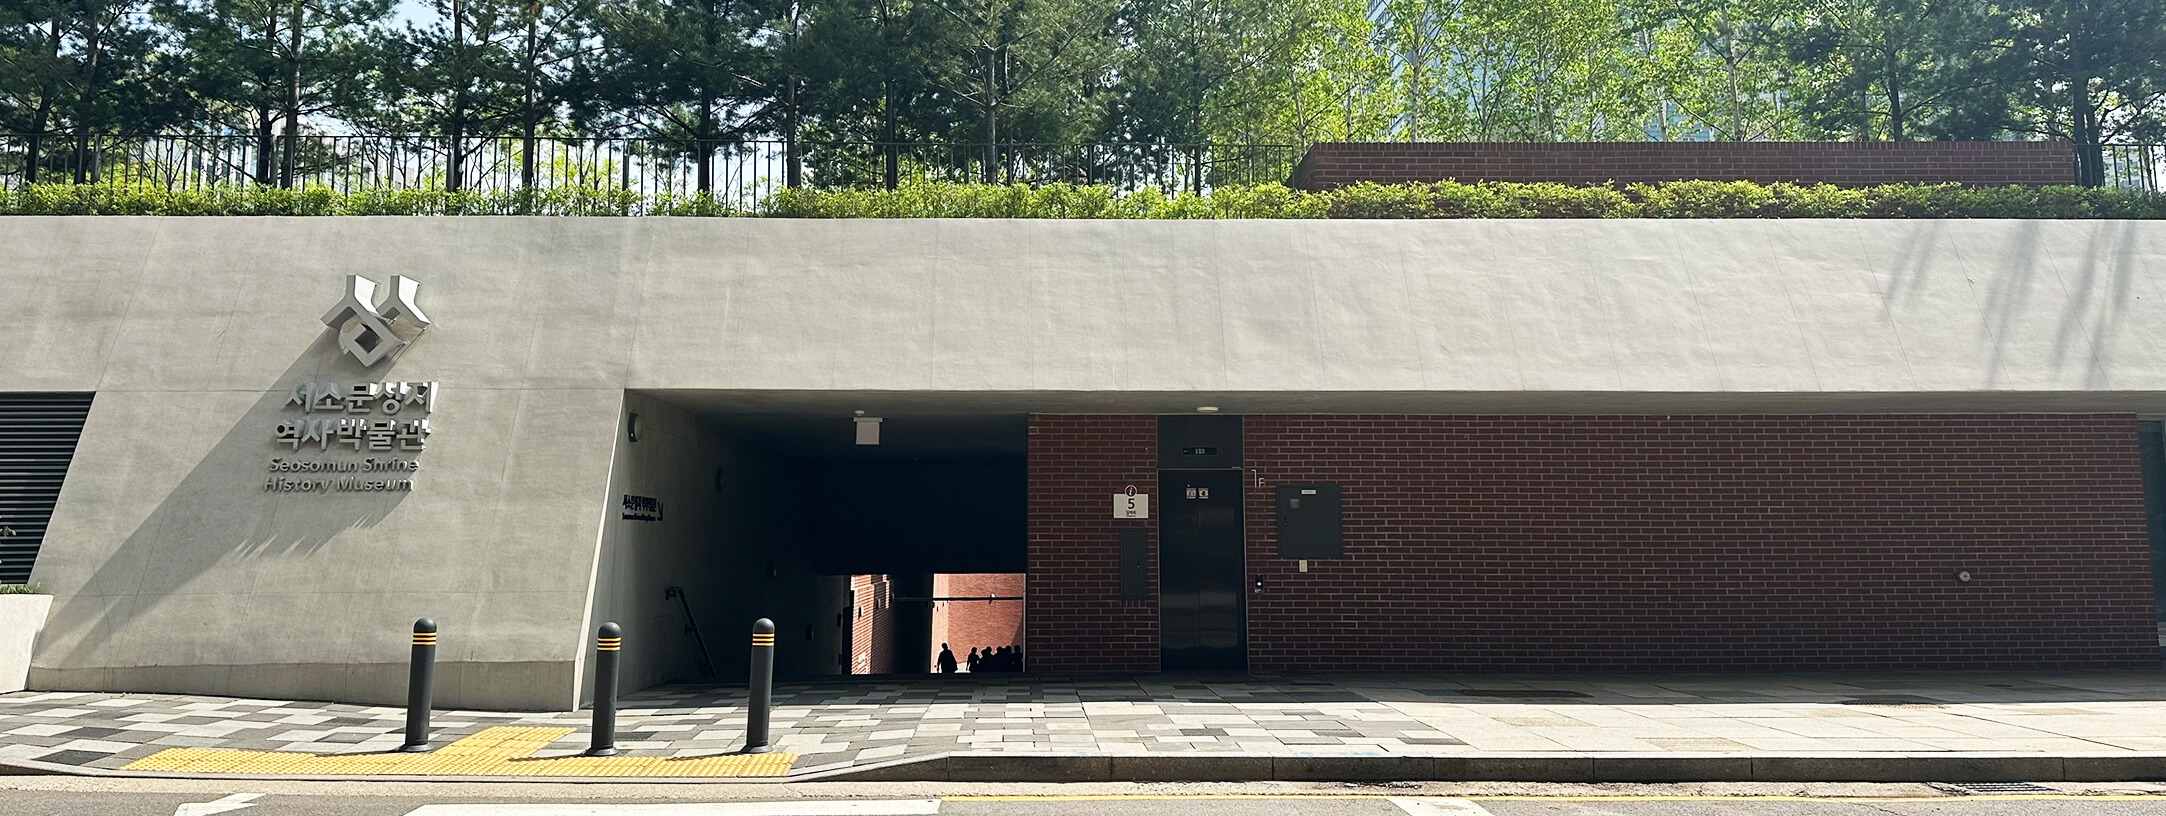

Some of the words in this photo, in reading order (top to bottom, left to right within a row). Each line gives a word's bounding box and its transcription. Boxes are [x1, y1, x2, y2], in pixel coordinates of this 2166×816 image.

[284, 381, 438, 415] 서소문성지
[274, 418, 431, 451] 역사박물관
[269, 457, 358, 473] Seosomun
[362, 457, 419, 473] Shrine
[264, 476, 333, 493] History
[336, 476, 414, 492] Museum
[1251, 469, 1265, 488] 1F
[1127, 498, 1135, 510] 5
